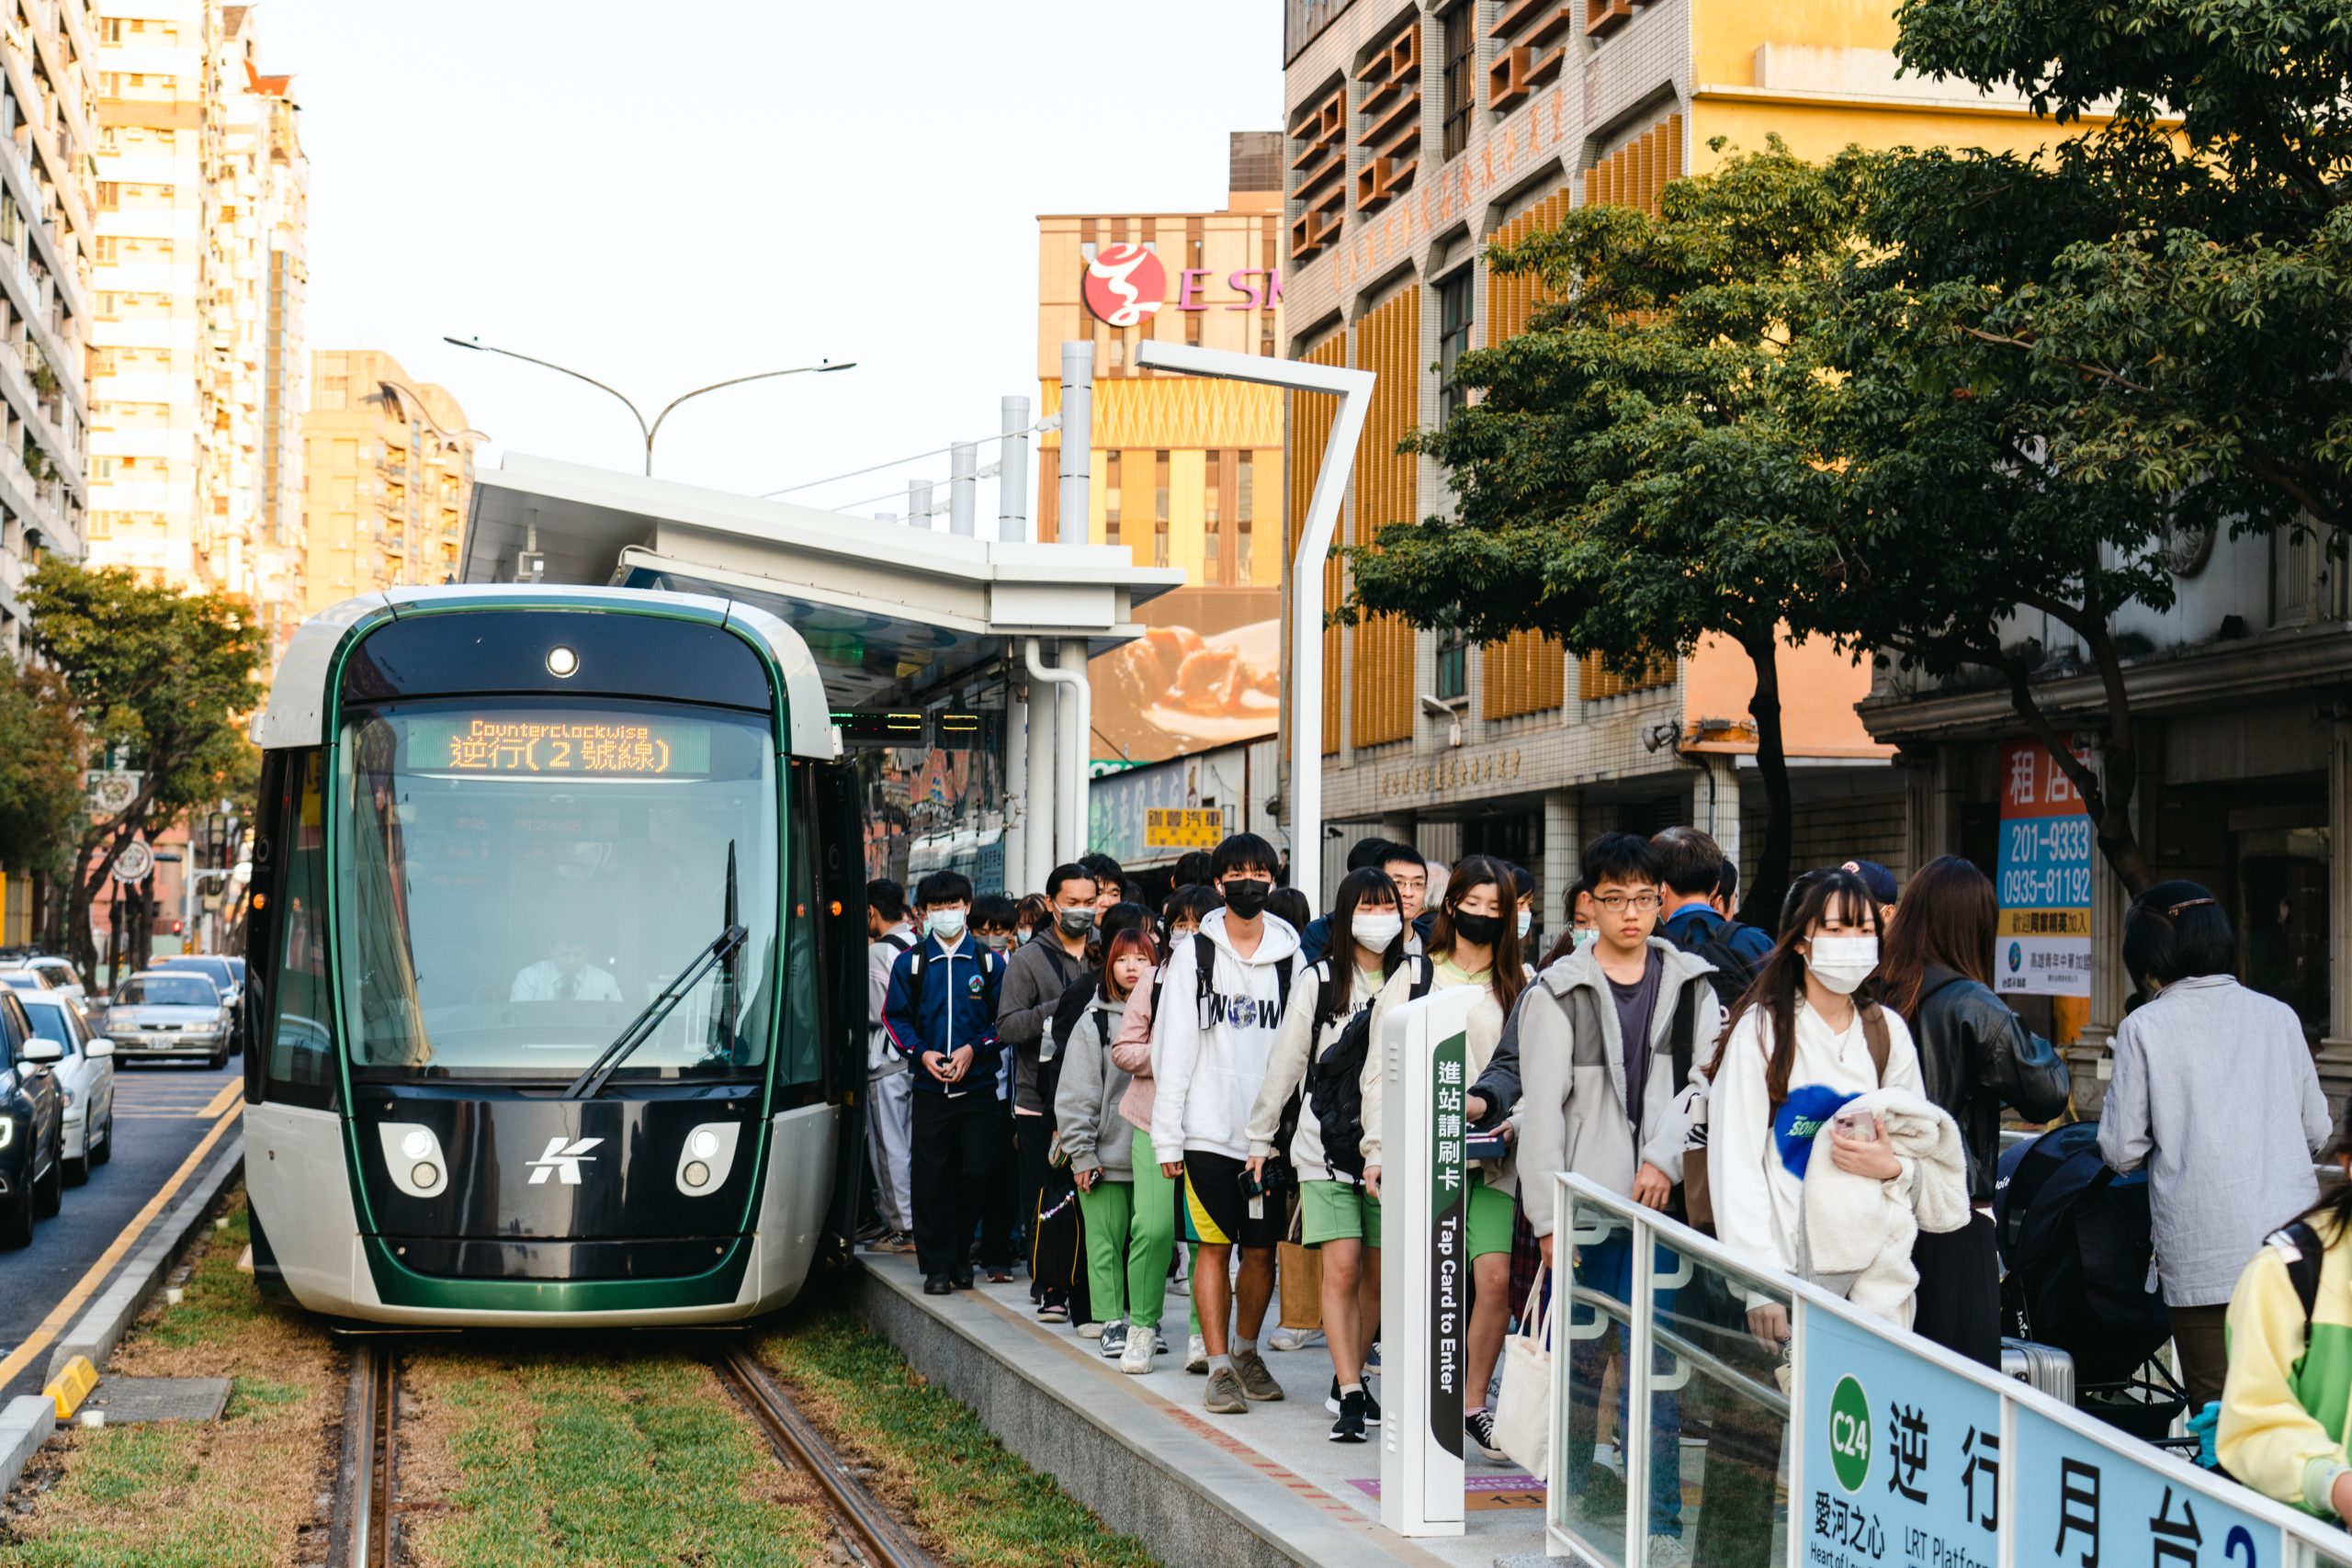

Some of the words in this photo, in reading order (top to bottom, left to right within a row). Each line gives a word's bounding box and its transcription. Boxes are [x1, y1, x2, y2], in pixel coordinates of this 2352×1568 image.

[471, 720, 648, 740] Counterclockwise
[2011, 820, 2089, 863] 201-9333
[1437, 1060, 1462, 1191] 進站請刷卡
[1437, 1216, 1457, 1256] Tap
[1437, 1259, 1457, 1309] Card
[1437, 1312, 1457, 1334] to
[1437, 1338, 1457, 1394] Enter
[1832, 1410, 1867, 1461] C24
[1815, 1491, 1885, 1561] 愛河之心
[1905, 1526, 1928, 1560] LRT
[1810, 1540, 1834, 1567] Heart
